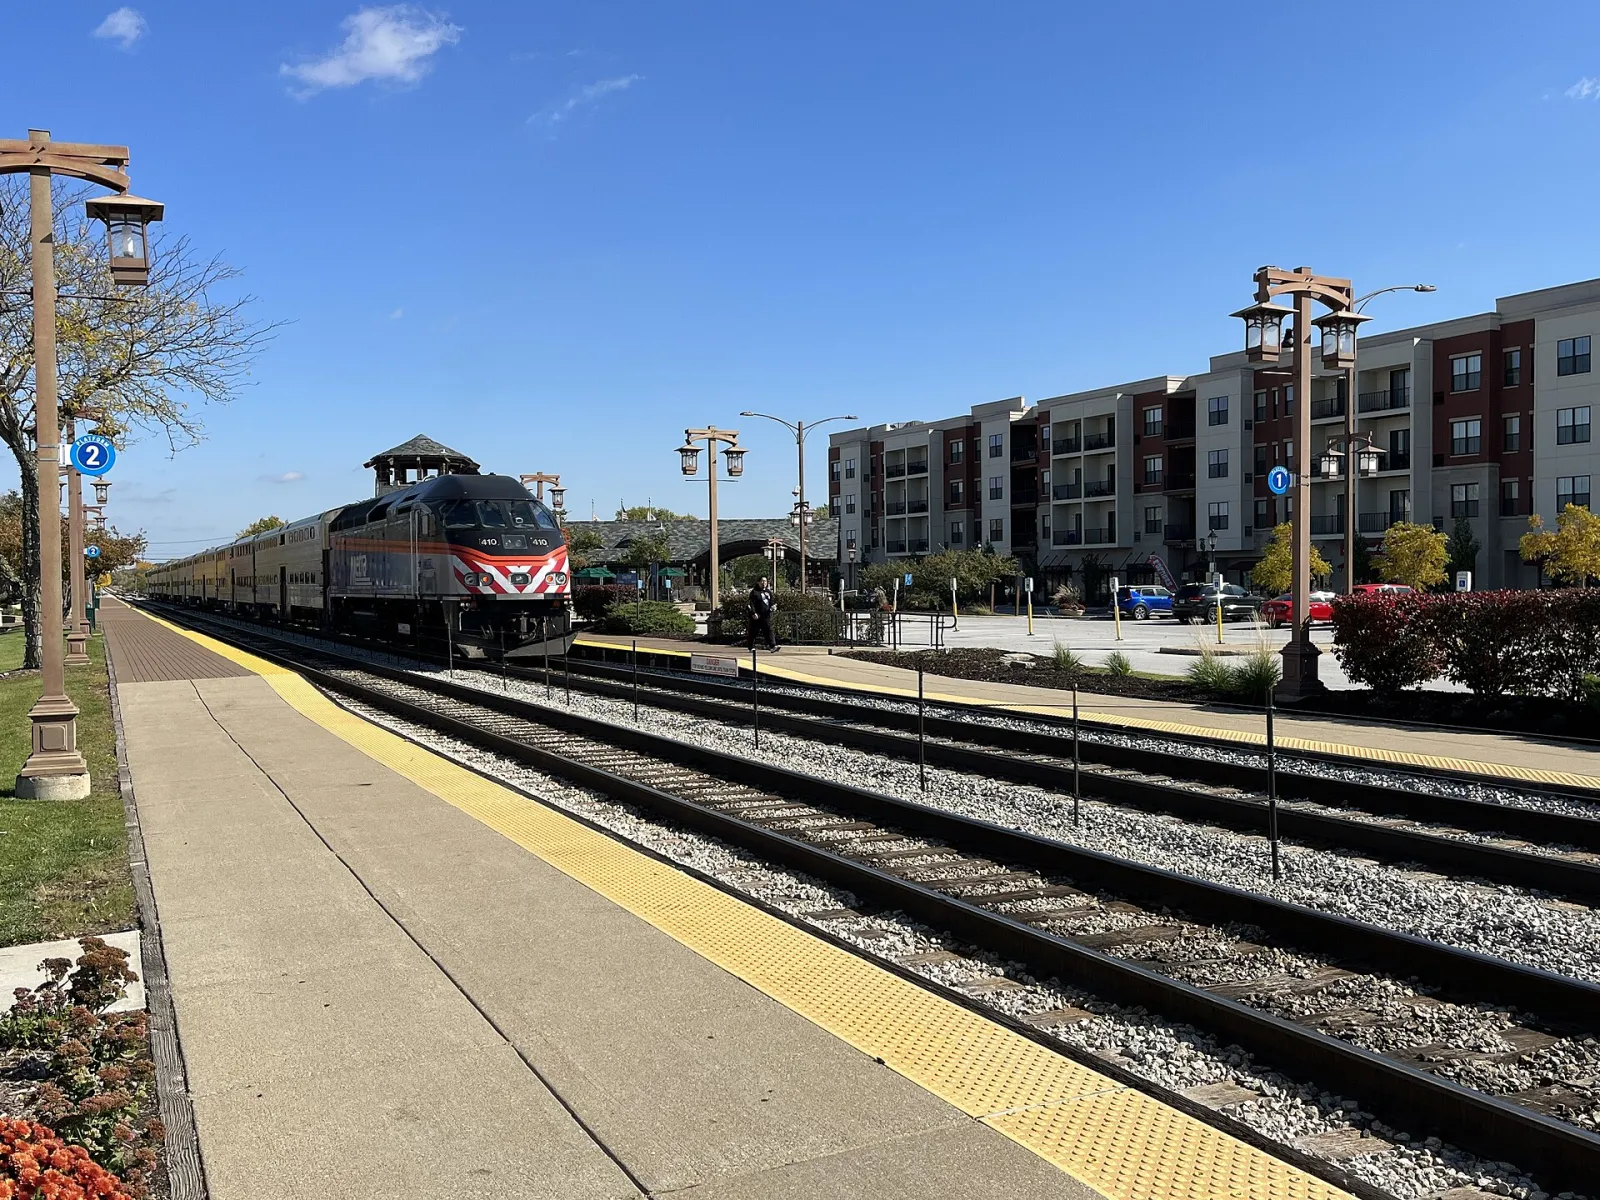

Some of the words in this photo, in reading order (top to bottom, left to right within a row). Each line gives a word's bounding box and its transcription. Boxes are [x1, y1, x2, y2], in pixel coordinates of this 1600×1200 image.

[75, 434, 110, 447] PLATFORM
[85, 445, 100, 466] 2
[1276, 473, 1282, 487] 1
[481, 538, 498, 546] 410
[532, 538, 548, 546] 410
